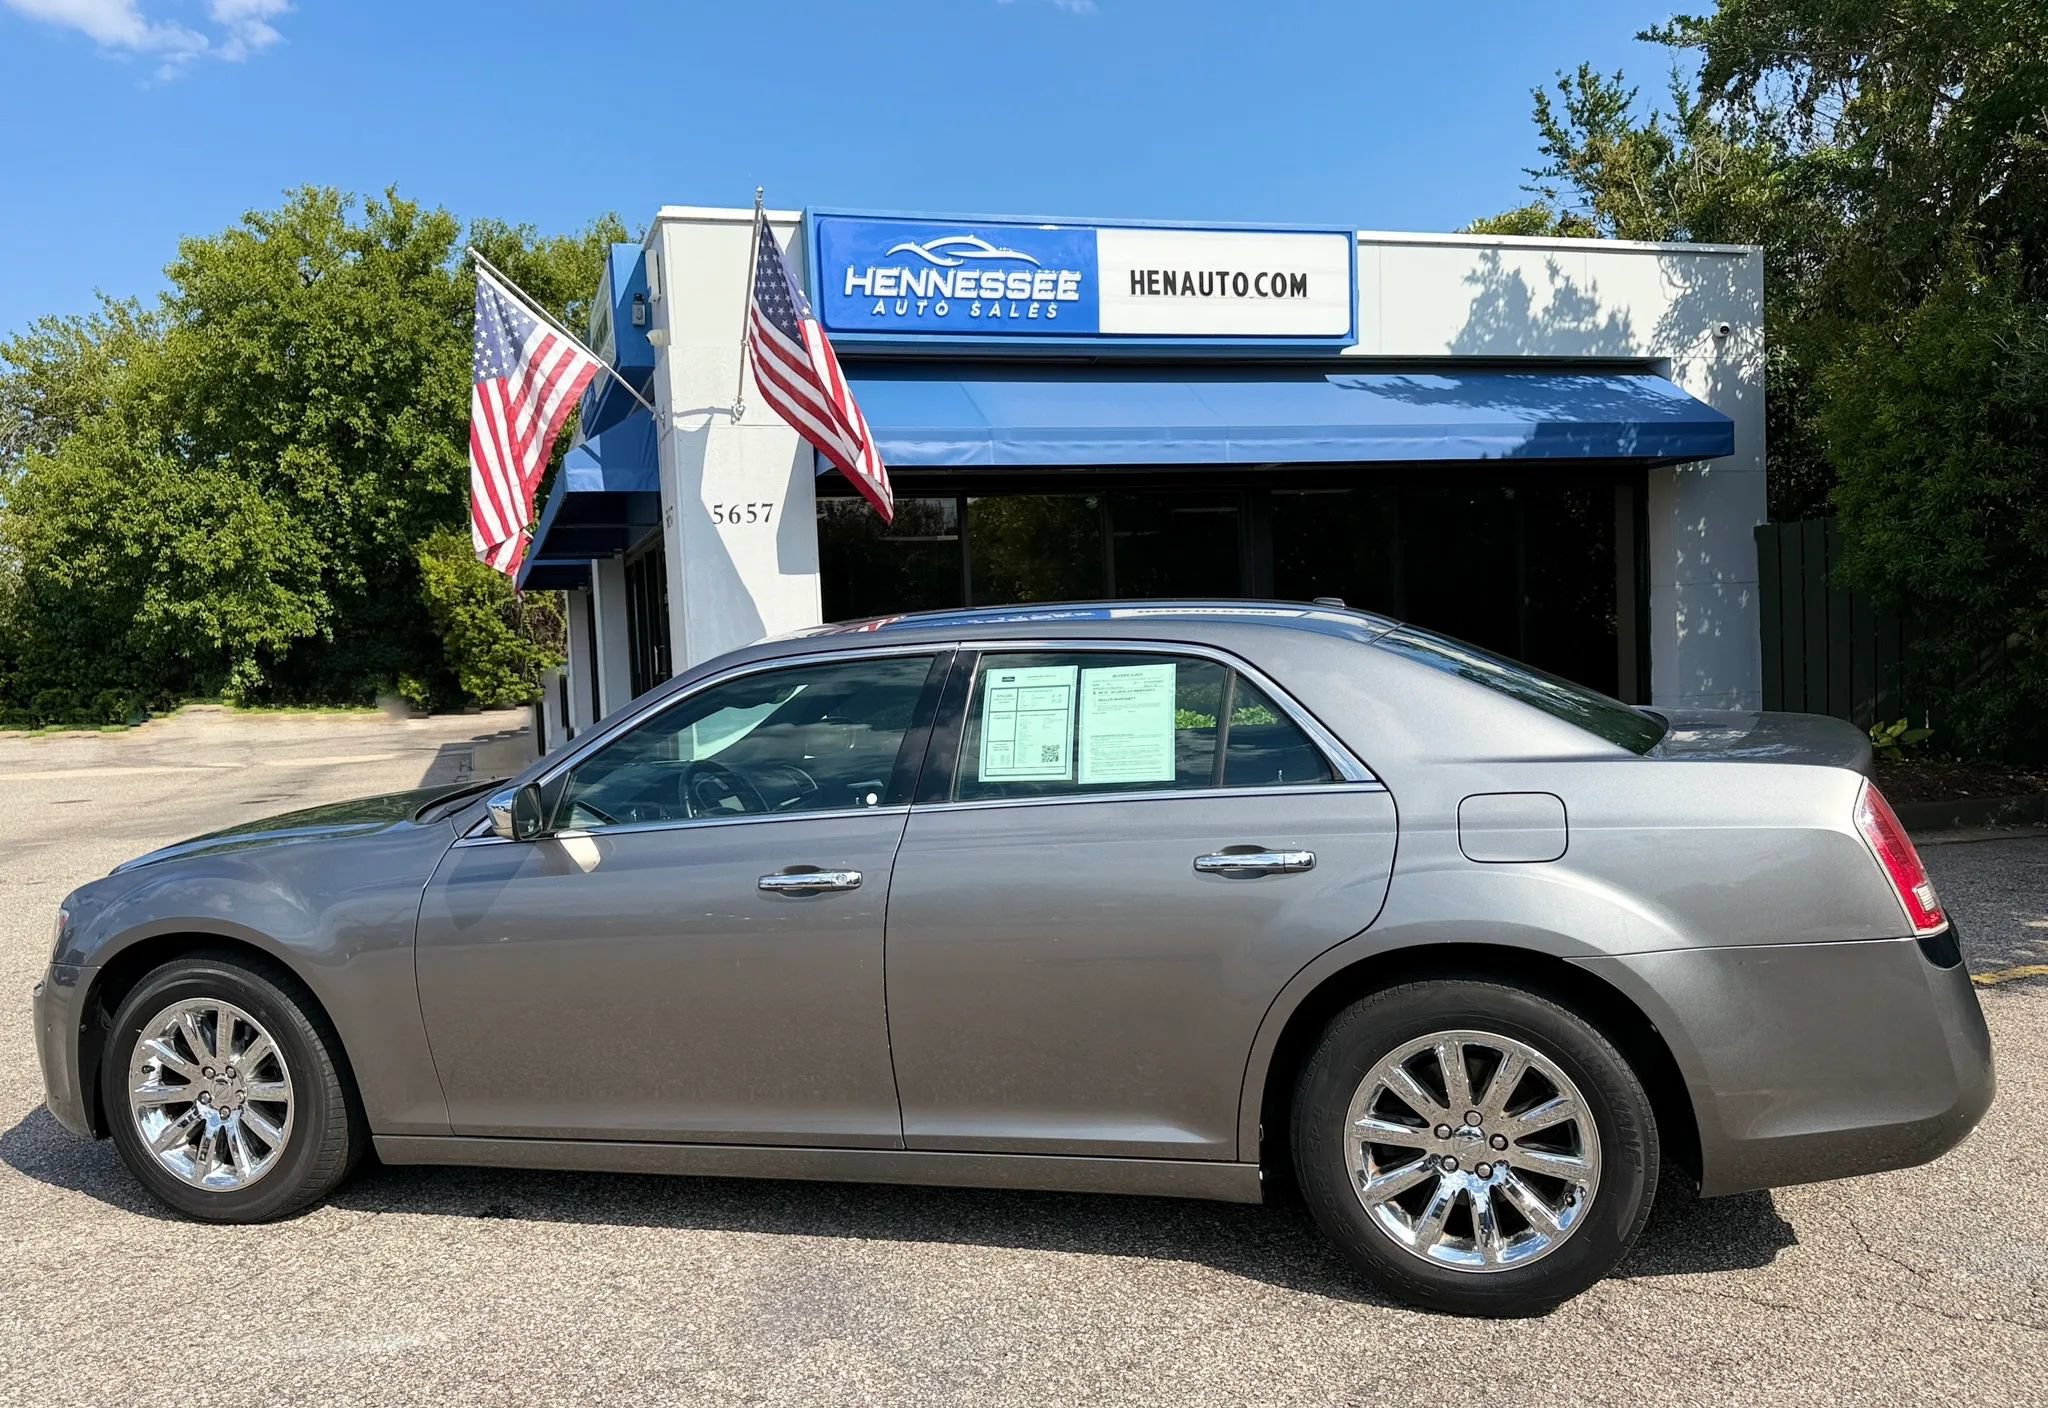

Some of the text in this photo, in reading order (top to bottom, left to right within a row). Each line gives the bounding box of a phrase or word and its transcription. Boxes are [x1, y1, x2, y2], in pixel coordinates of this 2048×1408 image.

[844, 266, 1081, 301] HENNESSEE
[872, 300, 1058, 319] AUTO SALES
[712, 502, 774, 525] 5657
